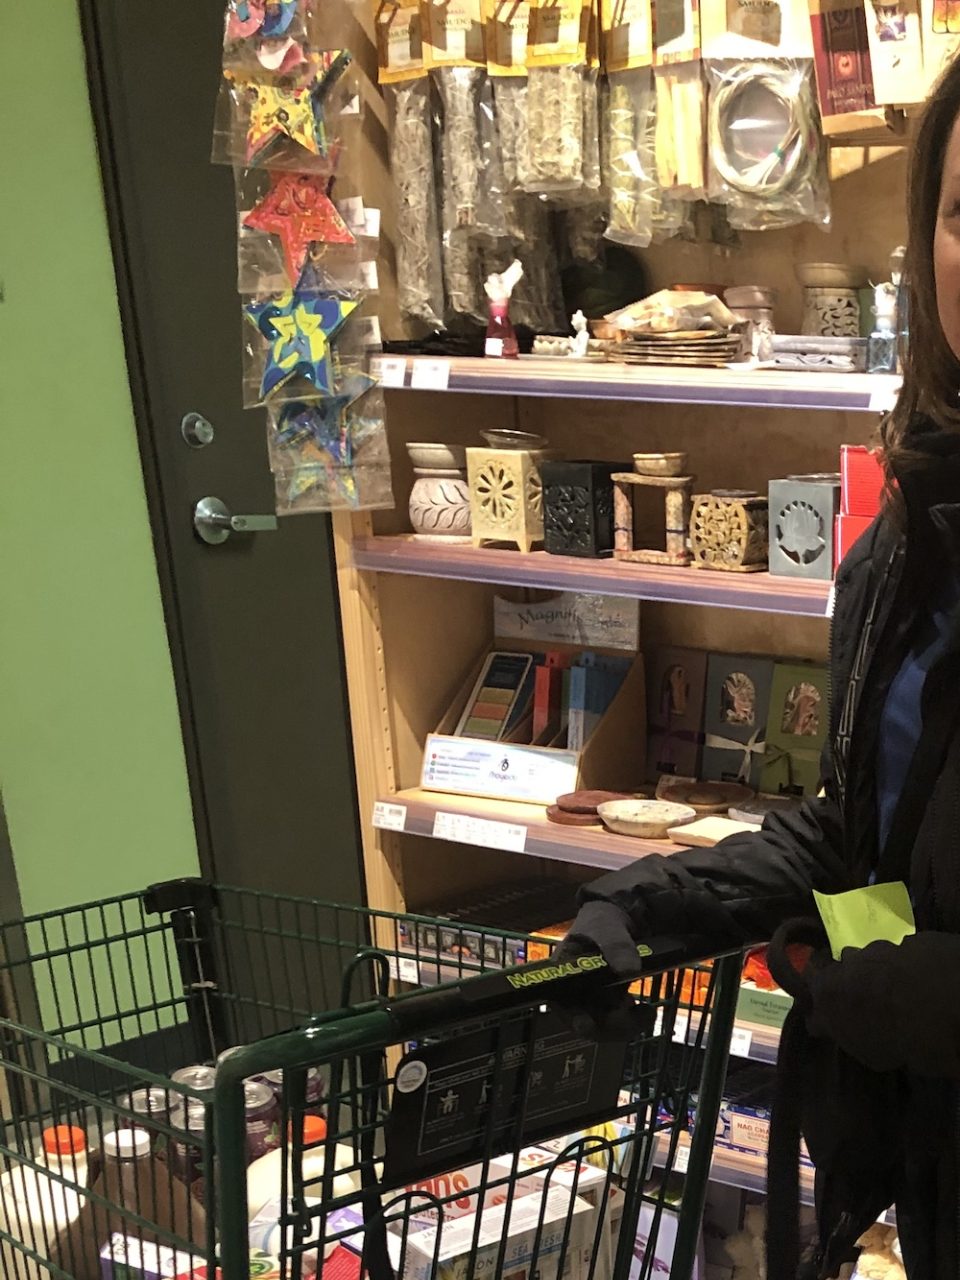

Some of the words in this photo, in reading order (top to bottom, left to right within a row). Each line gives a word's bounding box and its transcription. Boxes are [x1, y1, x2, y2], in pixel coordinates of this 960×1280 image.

[507, 962, 582, 988] NATURAL
[511, 1239, 529, 1258] SEA
[456, 1256, 495, 1278] JAON
